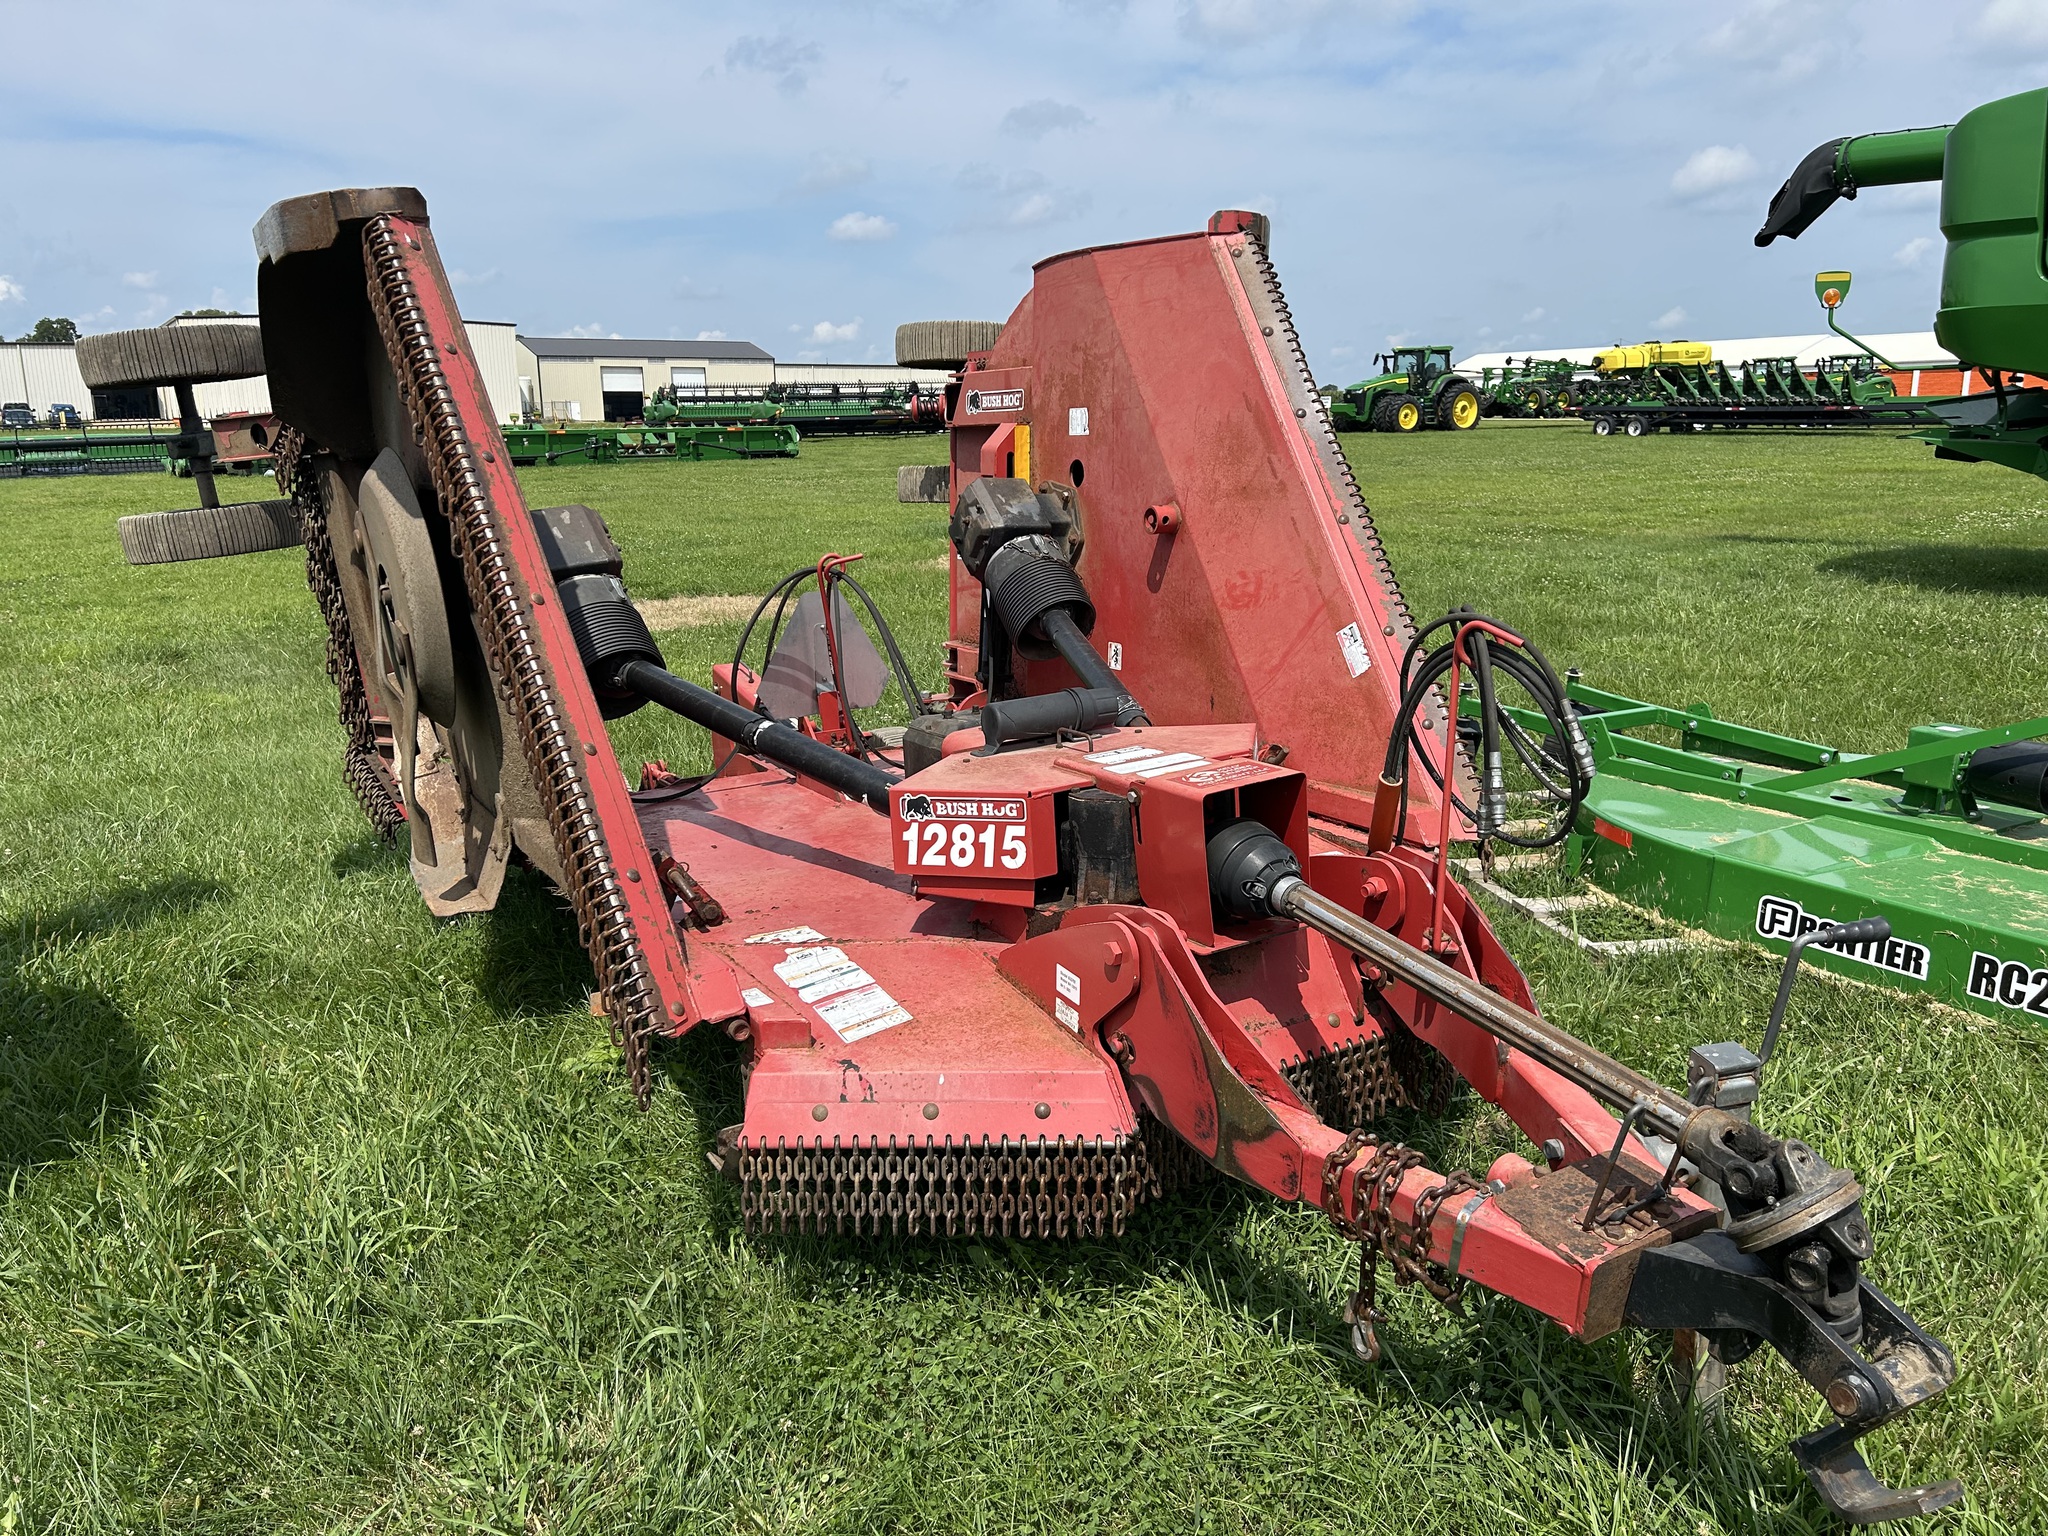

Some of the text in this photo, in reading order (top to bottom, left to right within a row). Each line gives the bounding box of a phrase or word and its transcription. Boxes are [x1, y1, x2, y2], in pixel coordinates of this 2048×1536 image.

[982, 394, 1021, 407] BUSH HOG
[936, 802, 978, 816] BUSH
[902, 822, 1027, 870] 12815
